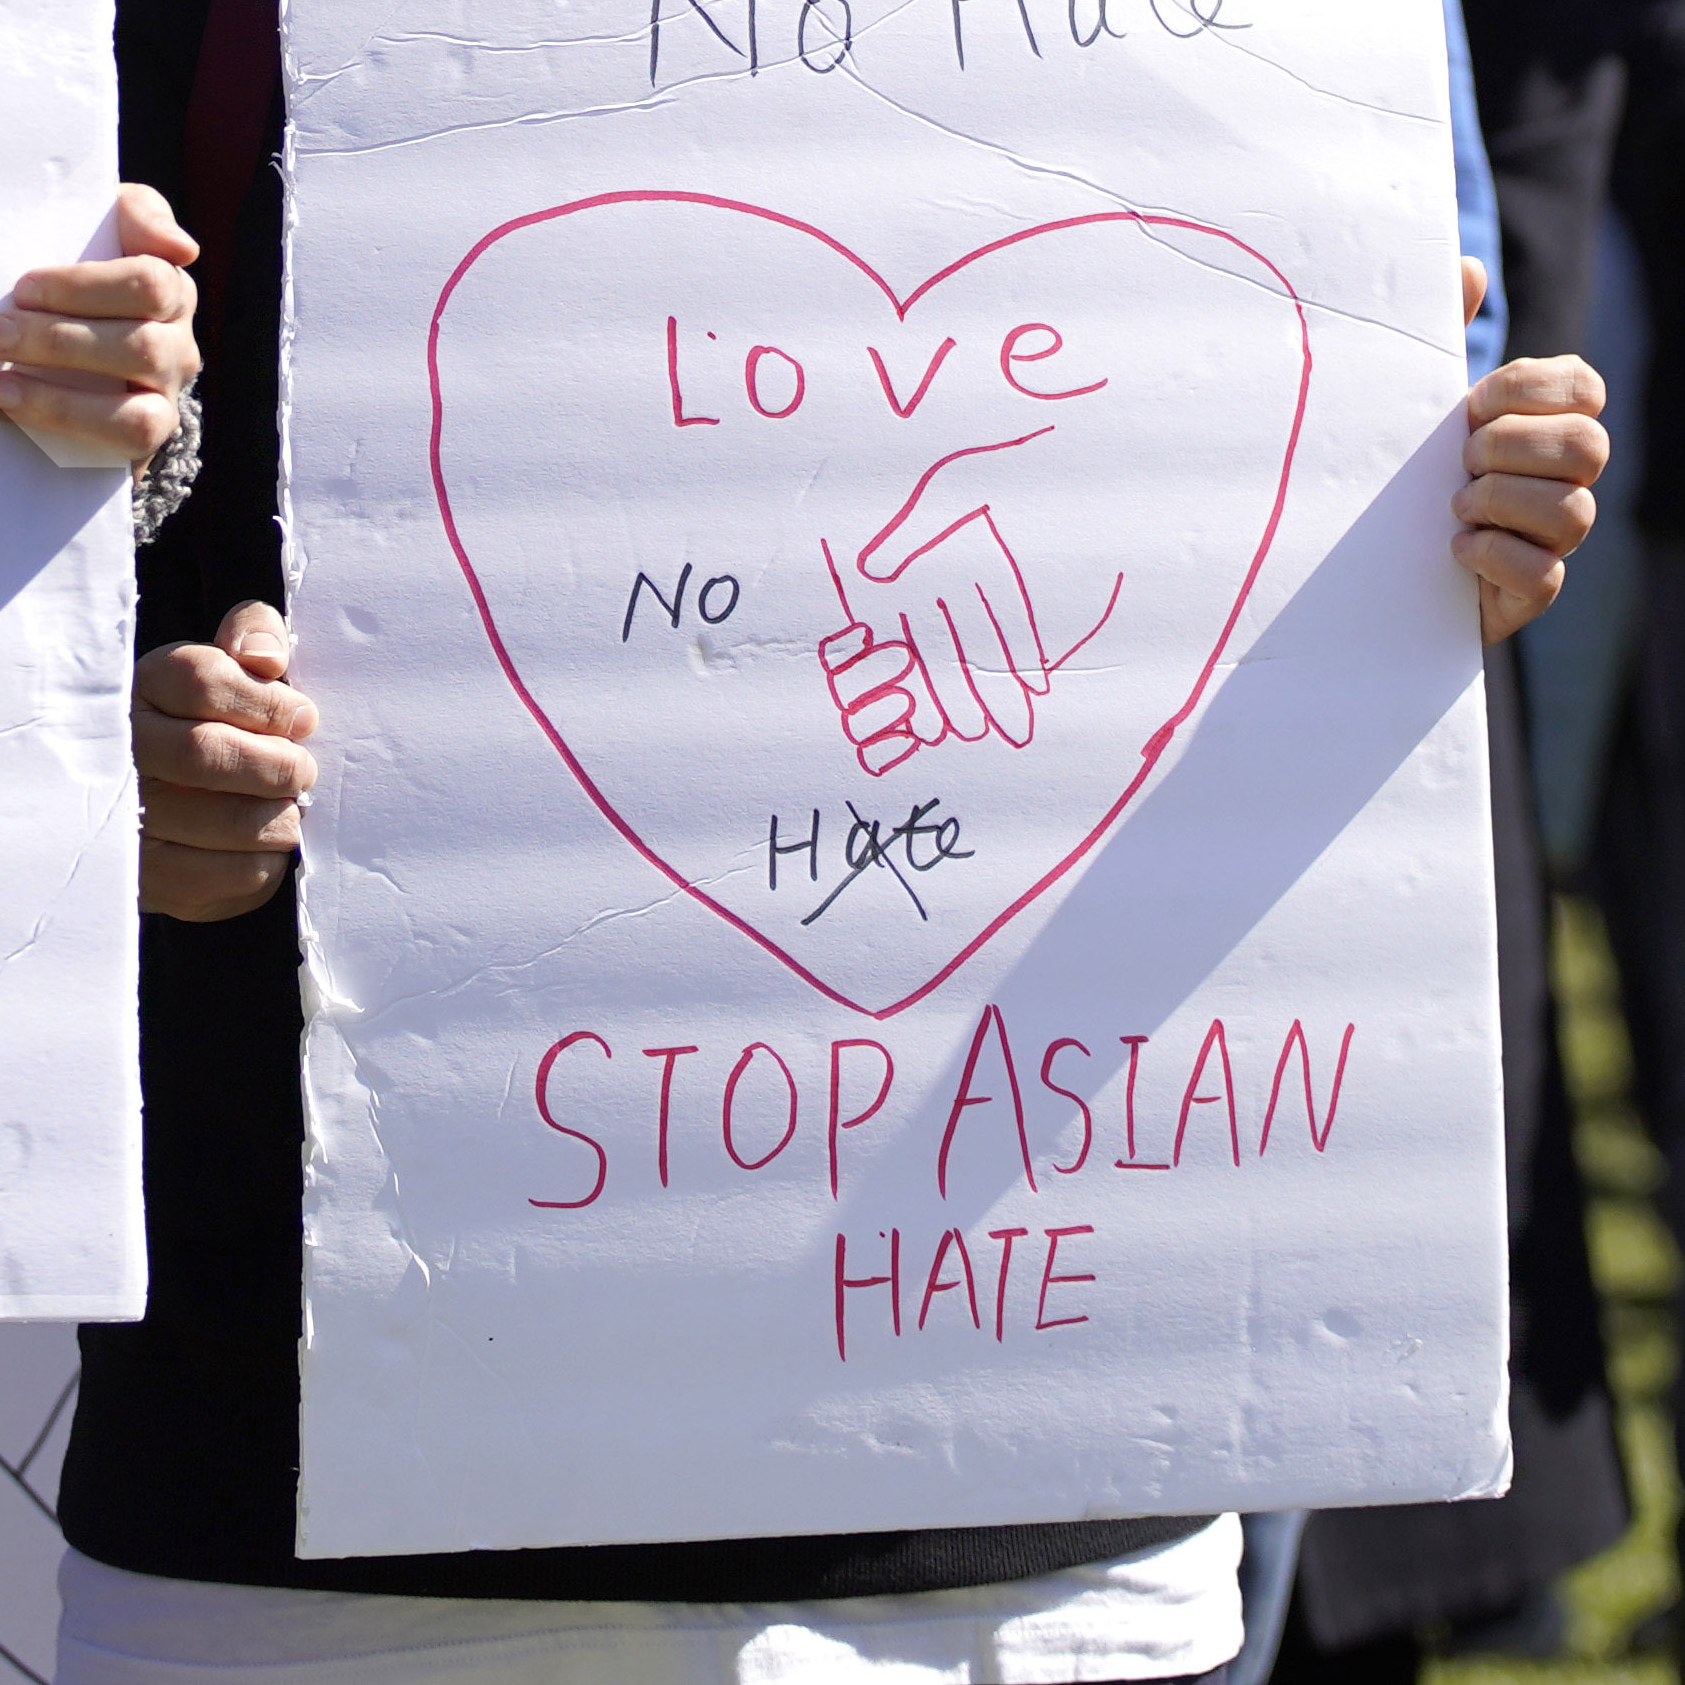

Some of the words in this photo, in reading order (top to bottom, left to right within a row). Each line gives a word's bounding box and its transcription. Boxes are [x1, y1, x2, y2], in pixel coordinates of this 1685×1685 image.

[667, 315, 1112, 427] Love
[769, 798, 975, 899] Hate
[528, 1030, 894, 1208] STOP
[938, 1005, 1354, 1196] ASIAN
[836, 1226, 1095, 1359] HATE
